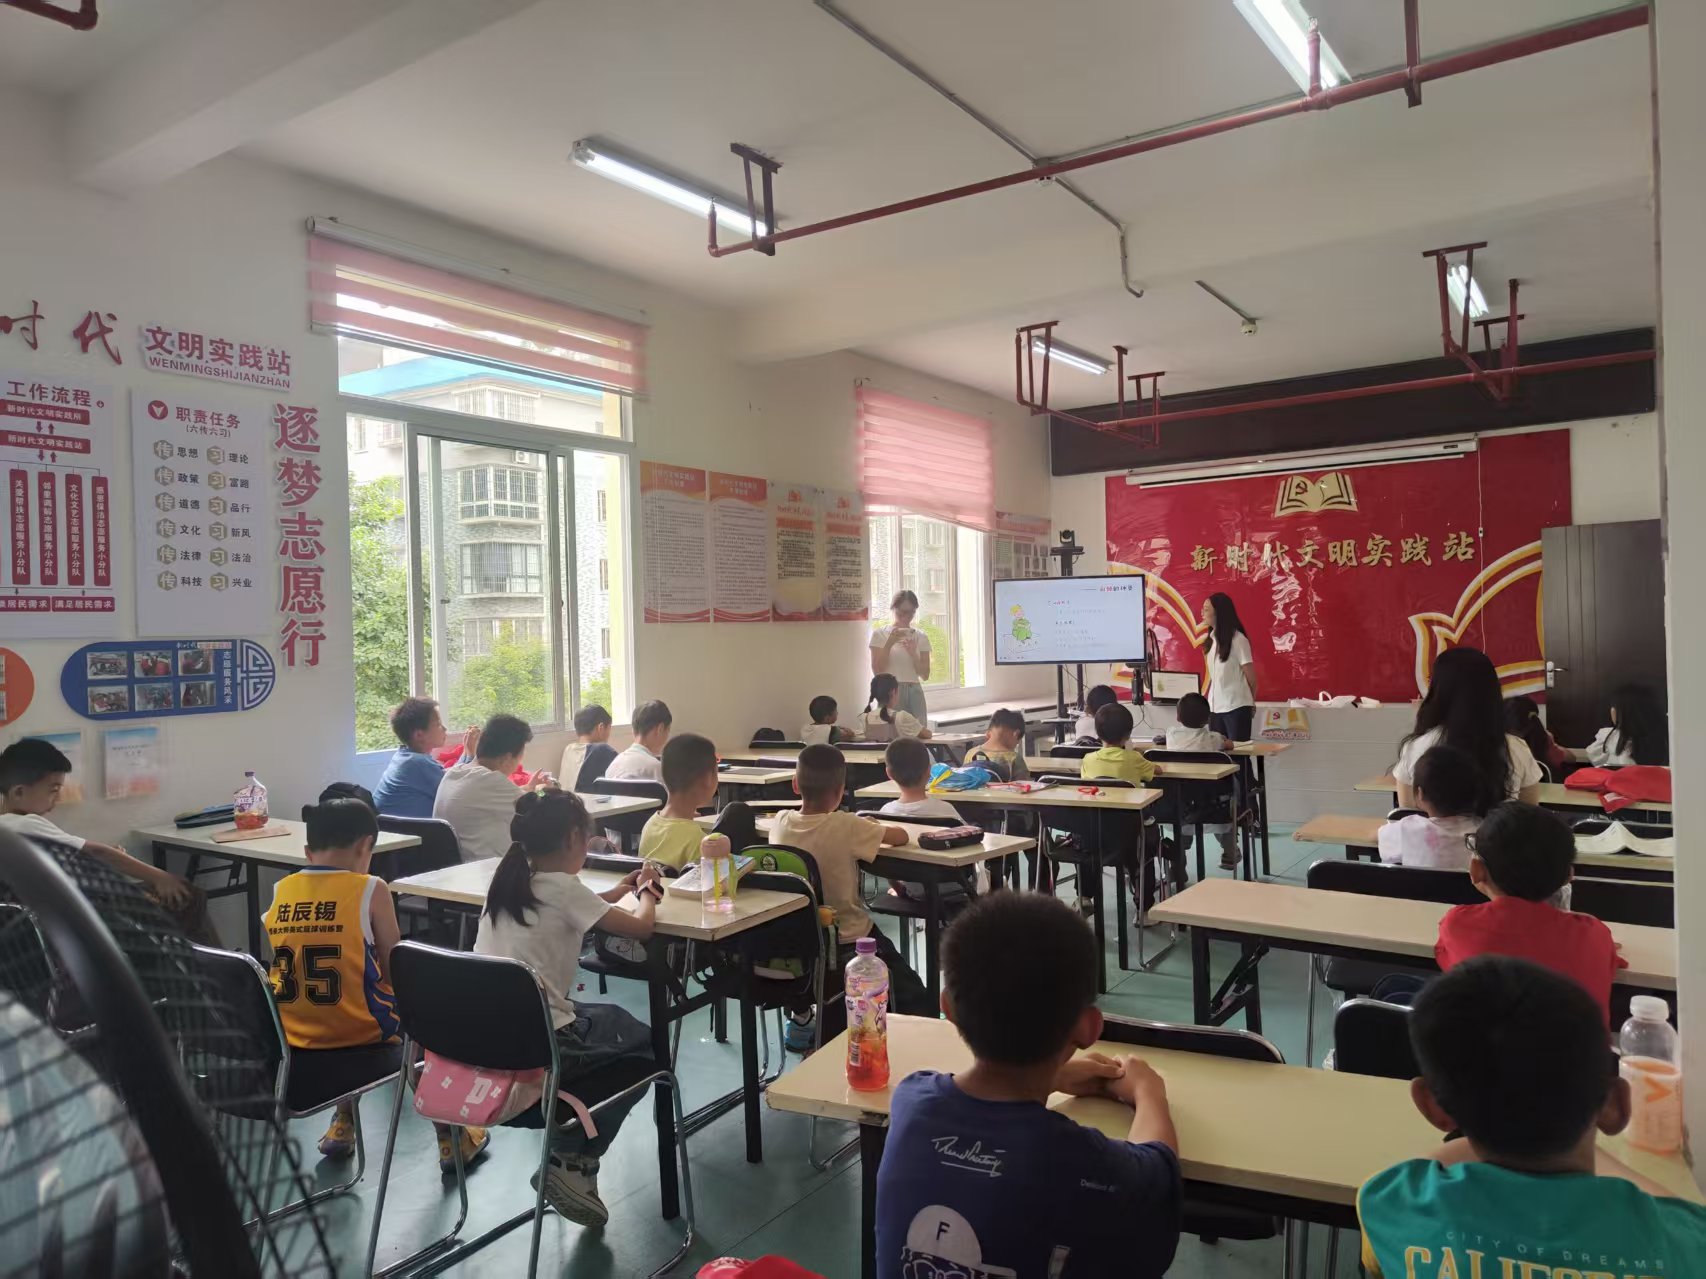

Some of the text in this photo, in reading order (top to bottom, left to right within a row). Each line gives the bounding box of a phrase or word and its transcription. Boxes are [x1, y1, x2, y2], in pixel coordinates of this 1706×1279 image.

[145, 326, 291, 377] 文明实践站
[148, 356, 291, 389] WENMINGSHIJIANZHAN
[7, 380, 92, 408] 工作流程
[175, 406, 241, 430] 职责任务
[7, 434, 84, 450] 新时代文明实践站
[230, 503, 251, 514] 品行
[179, 524, 201, 536] 文化
[231, 527, 252, 538] 新风
[273, 402, 327, 668] 逐梦志愿行
[1190, 532, 1475, 575] 新时代文明实践站
[180, 576, 203, 588] 科技
[232, 577, 252, 588] 兴业
[274, 901, 338, 924] 陆辰锡
[271, 944, 342, 1006] 35
[935, 1221, 951, 1241] F
[1446, 1231, 1665, 1270] CITY OF DREAMS
